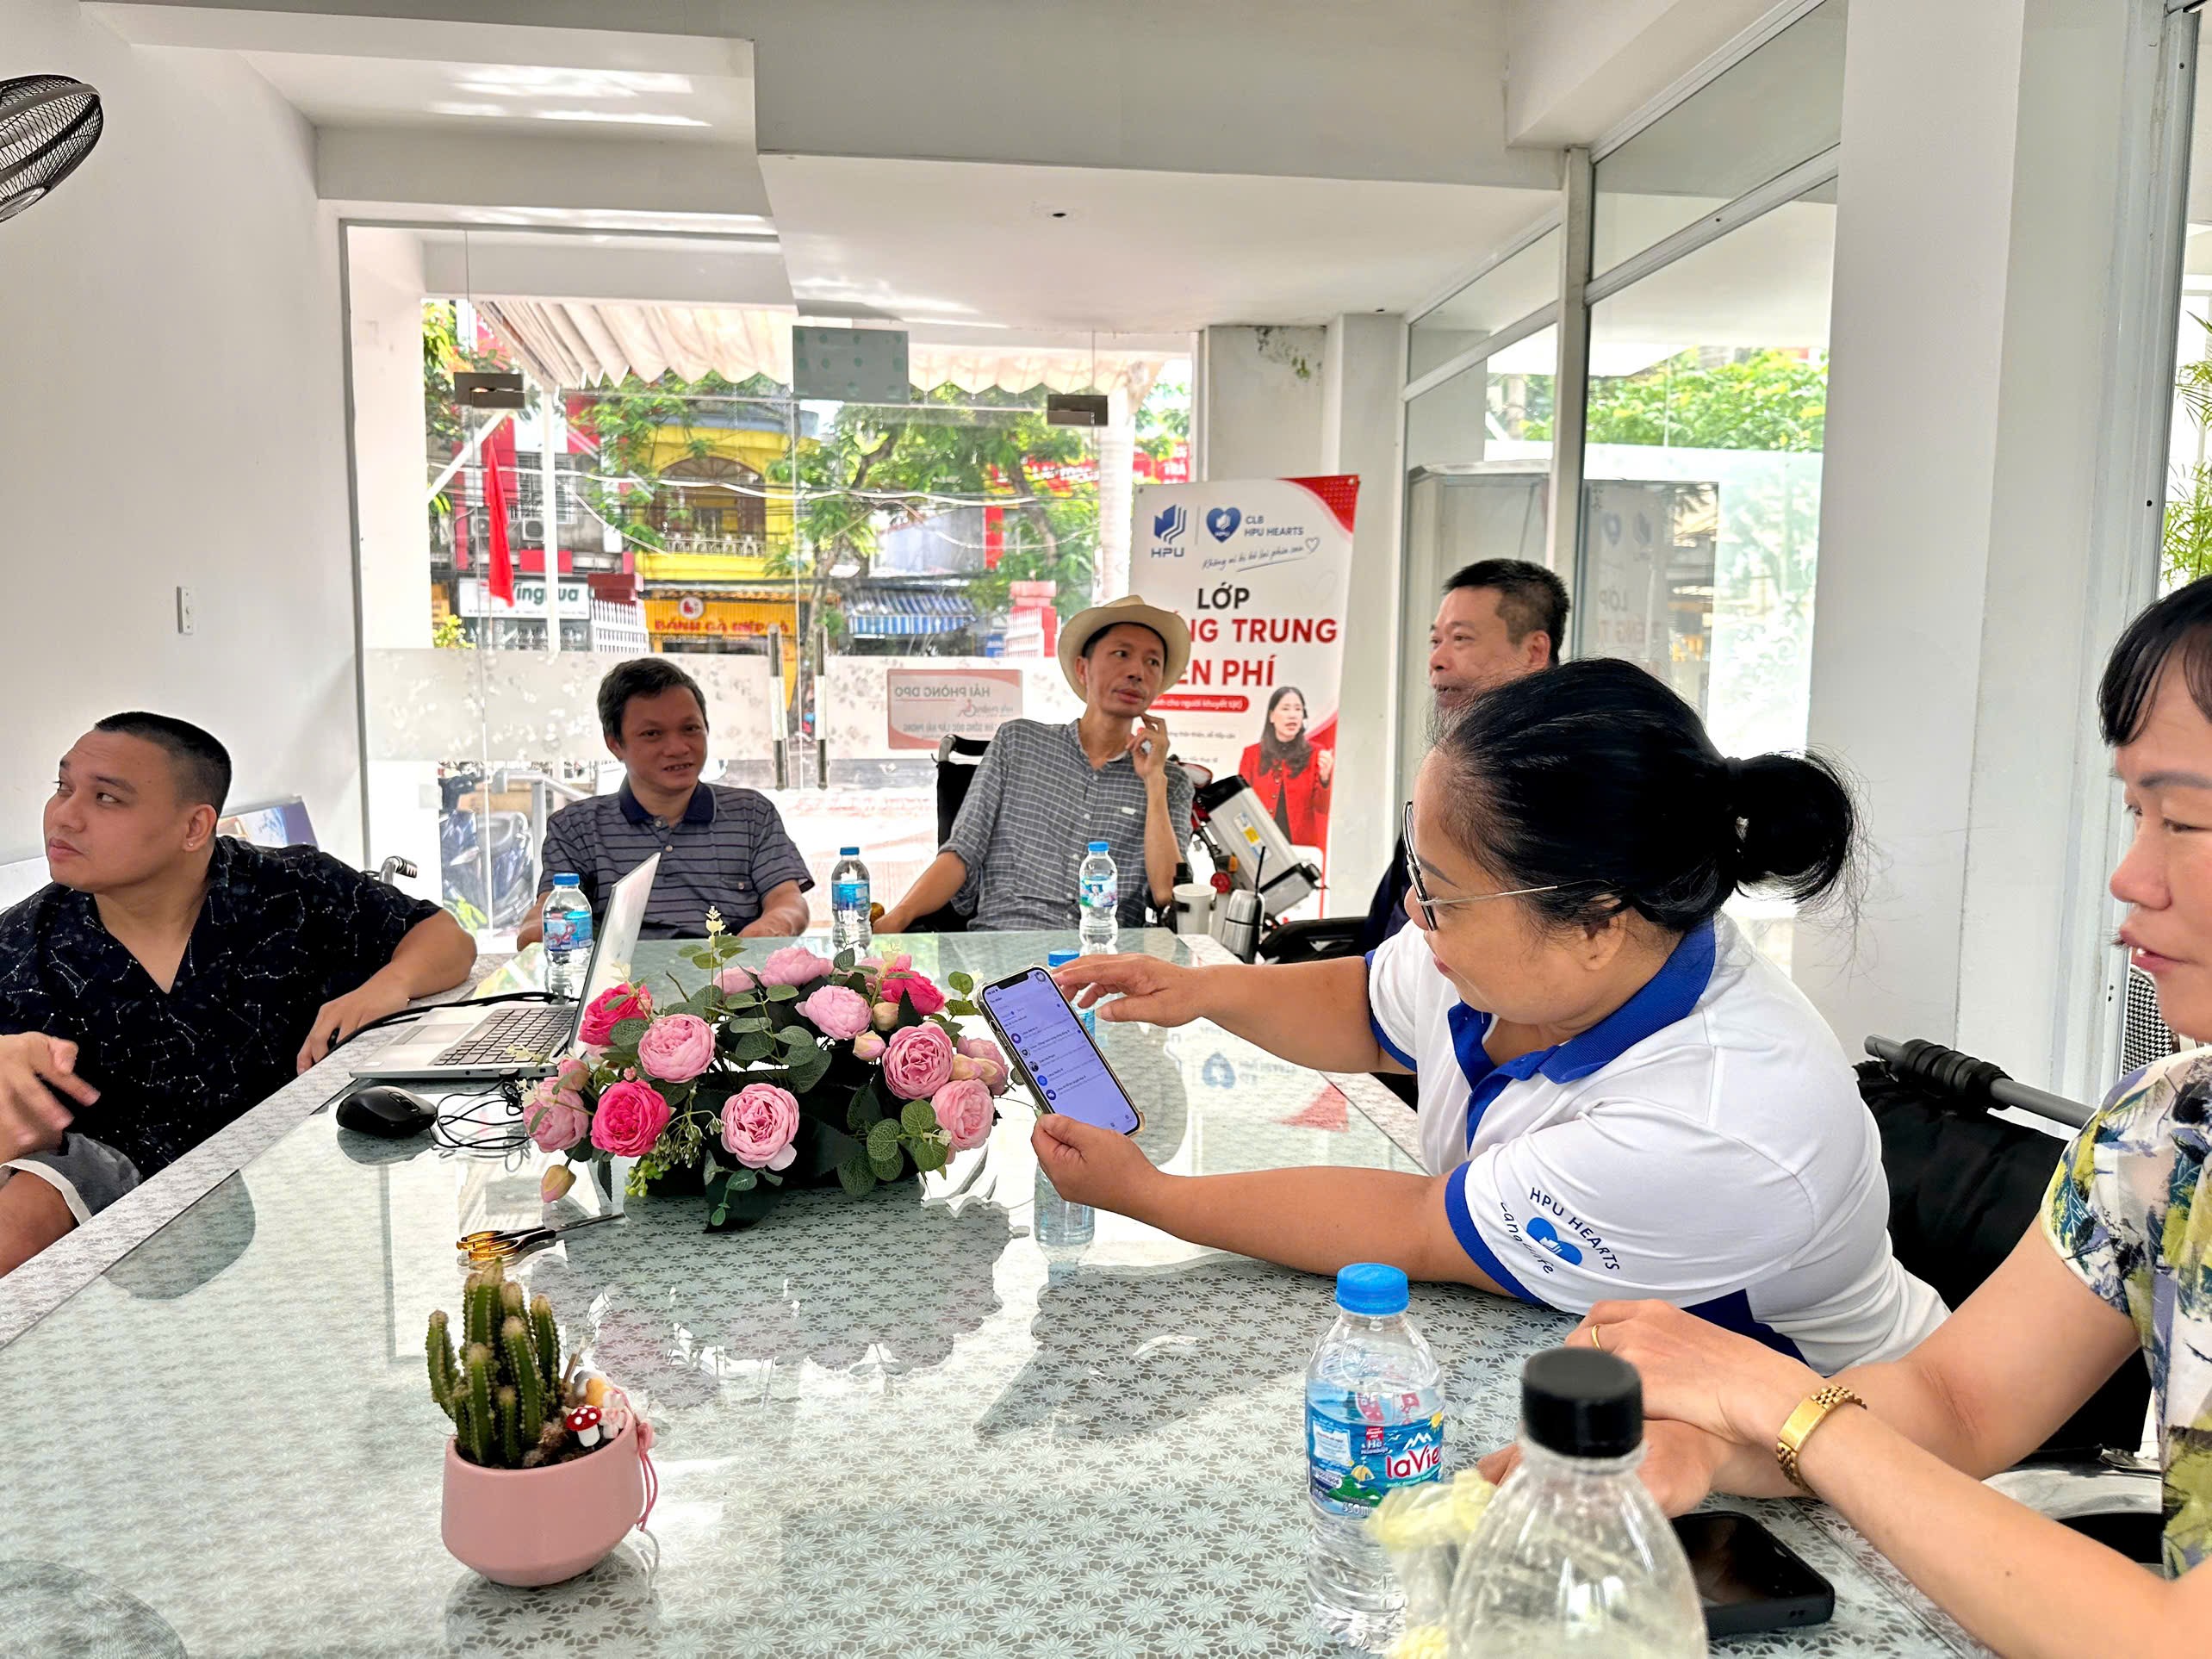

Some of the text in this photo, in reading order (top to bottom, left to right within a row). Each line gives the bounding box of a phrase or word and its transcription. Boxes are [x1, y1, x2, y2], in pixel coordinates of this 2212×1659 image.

[1244, 526, 1304, 537] HPU HEARTS
[1246, 515, 1264, 525] CLB
[1151, 547, 1184, 558] HPU
[1197, 581, 1250, 610] LỚP
[1233, 618, 1339, 643] TRUNG
[1221, 655, 1277, 687] PHÍ
[1530, 1187, 1620, 1271] HPU HEARTS
[1386, 1444, 1440, 1479] laVie
